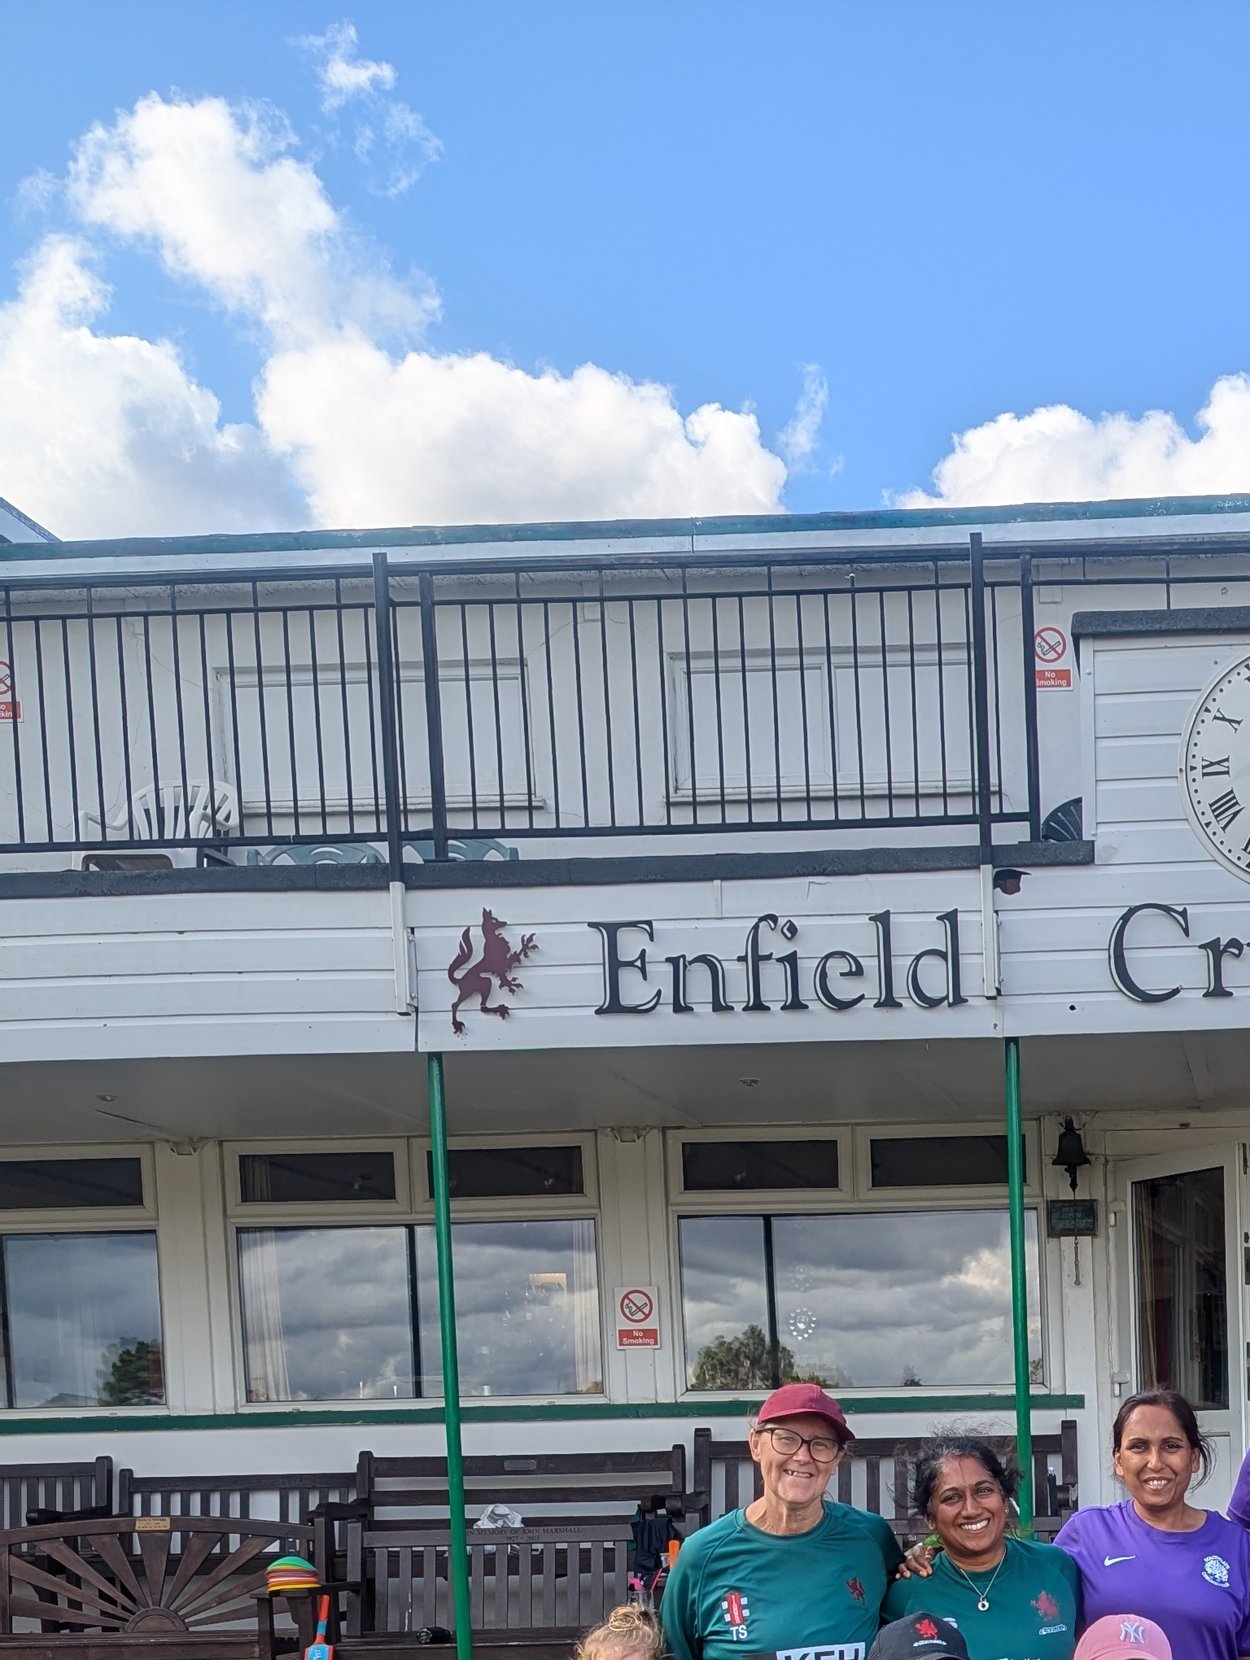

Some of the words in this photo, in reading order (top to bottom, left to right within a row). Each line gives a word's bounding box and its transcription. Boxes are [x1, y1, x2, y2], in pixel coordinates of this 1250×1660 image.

[587, 908, 968, 1015] Enfield
[622, 1337, 655, 1346] Smoking
[730, 1624, 748, 1641] TS
